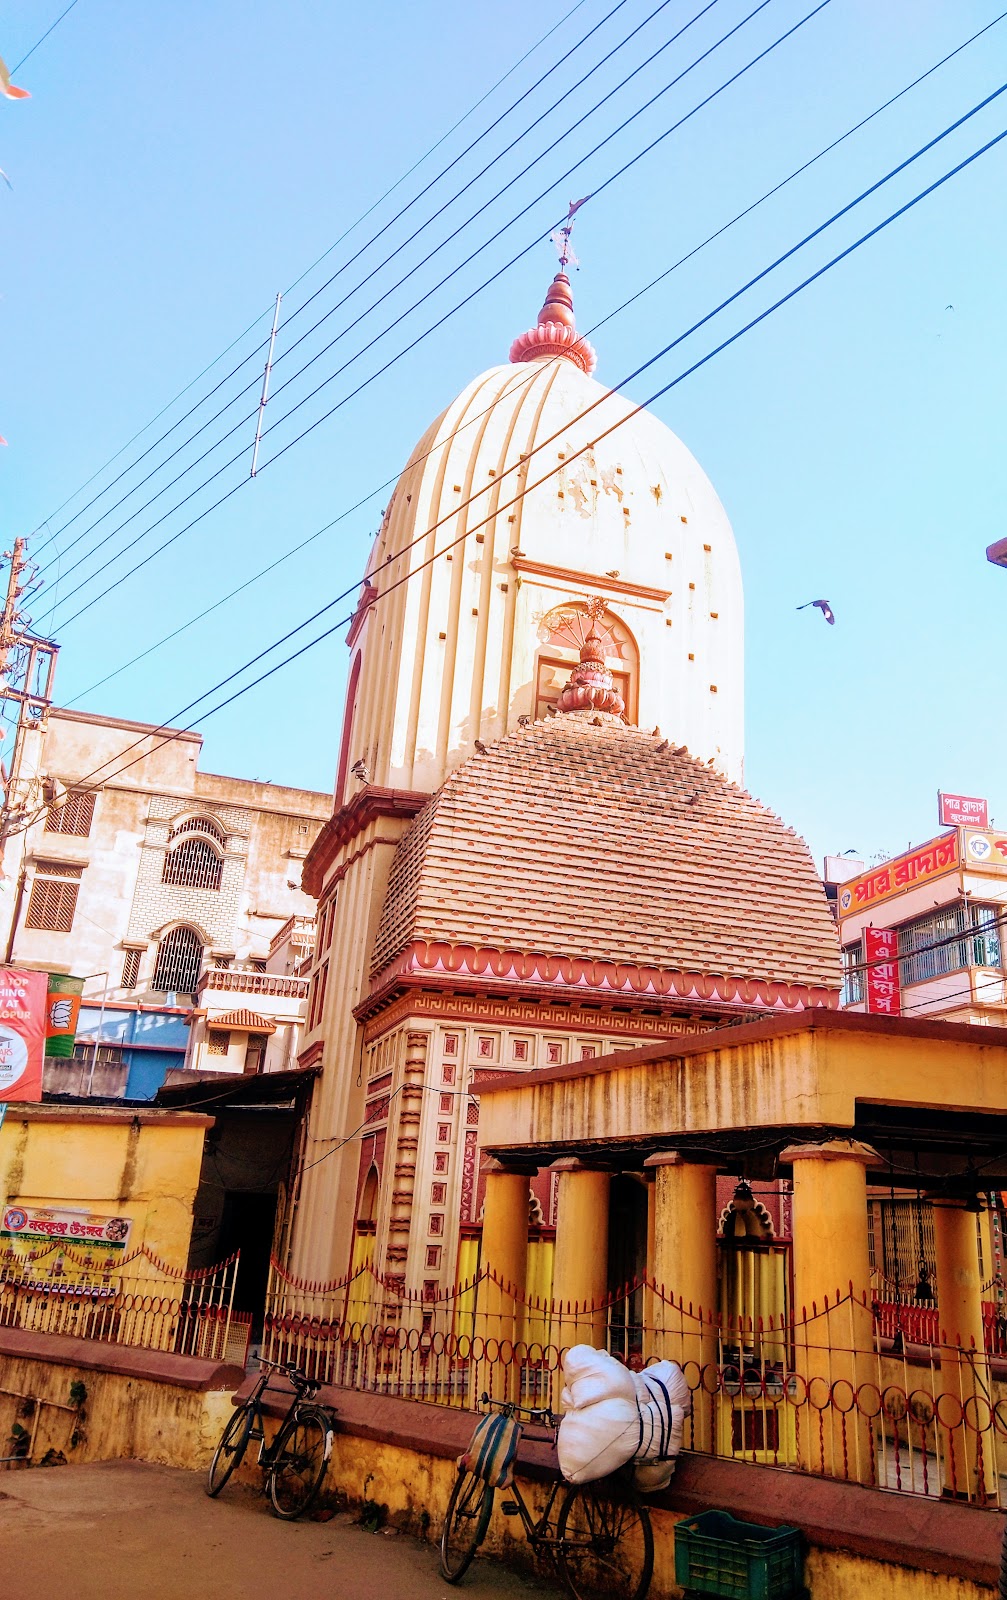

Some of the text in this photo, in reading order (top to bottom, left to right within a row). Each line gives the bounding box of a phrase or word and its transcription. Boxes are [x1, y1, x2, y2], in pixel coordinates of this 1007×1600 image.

[944, 798, 985, 814] পাত্র ব্রাদার্স
[854, 869, 892, 902] পাত্র
[894, 834, 957, 887] ব্রাদার্স
[8, 977, 29, 987] TOP
[6, 999, 19, 1008] AT
[0, 1010, 31, 1019] GPUR
[70, 1220, 104, 1237] উৎসব
